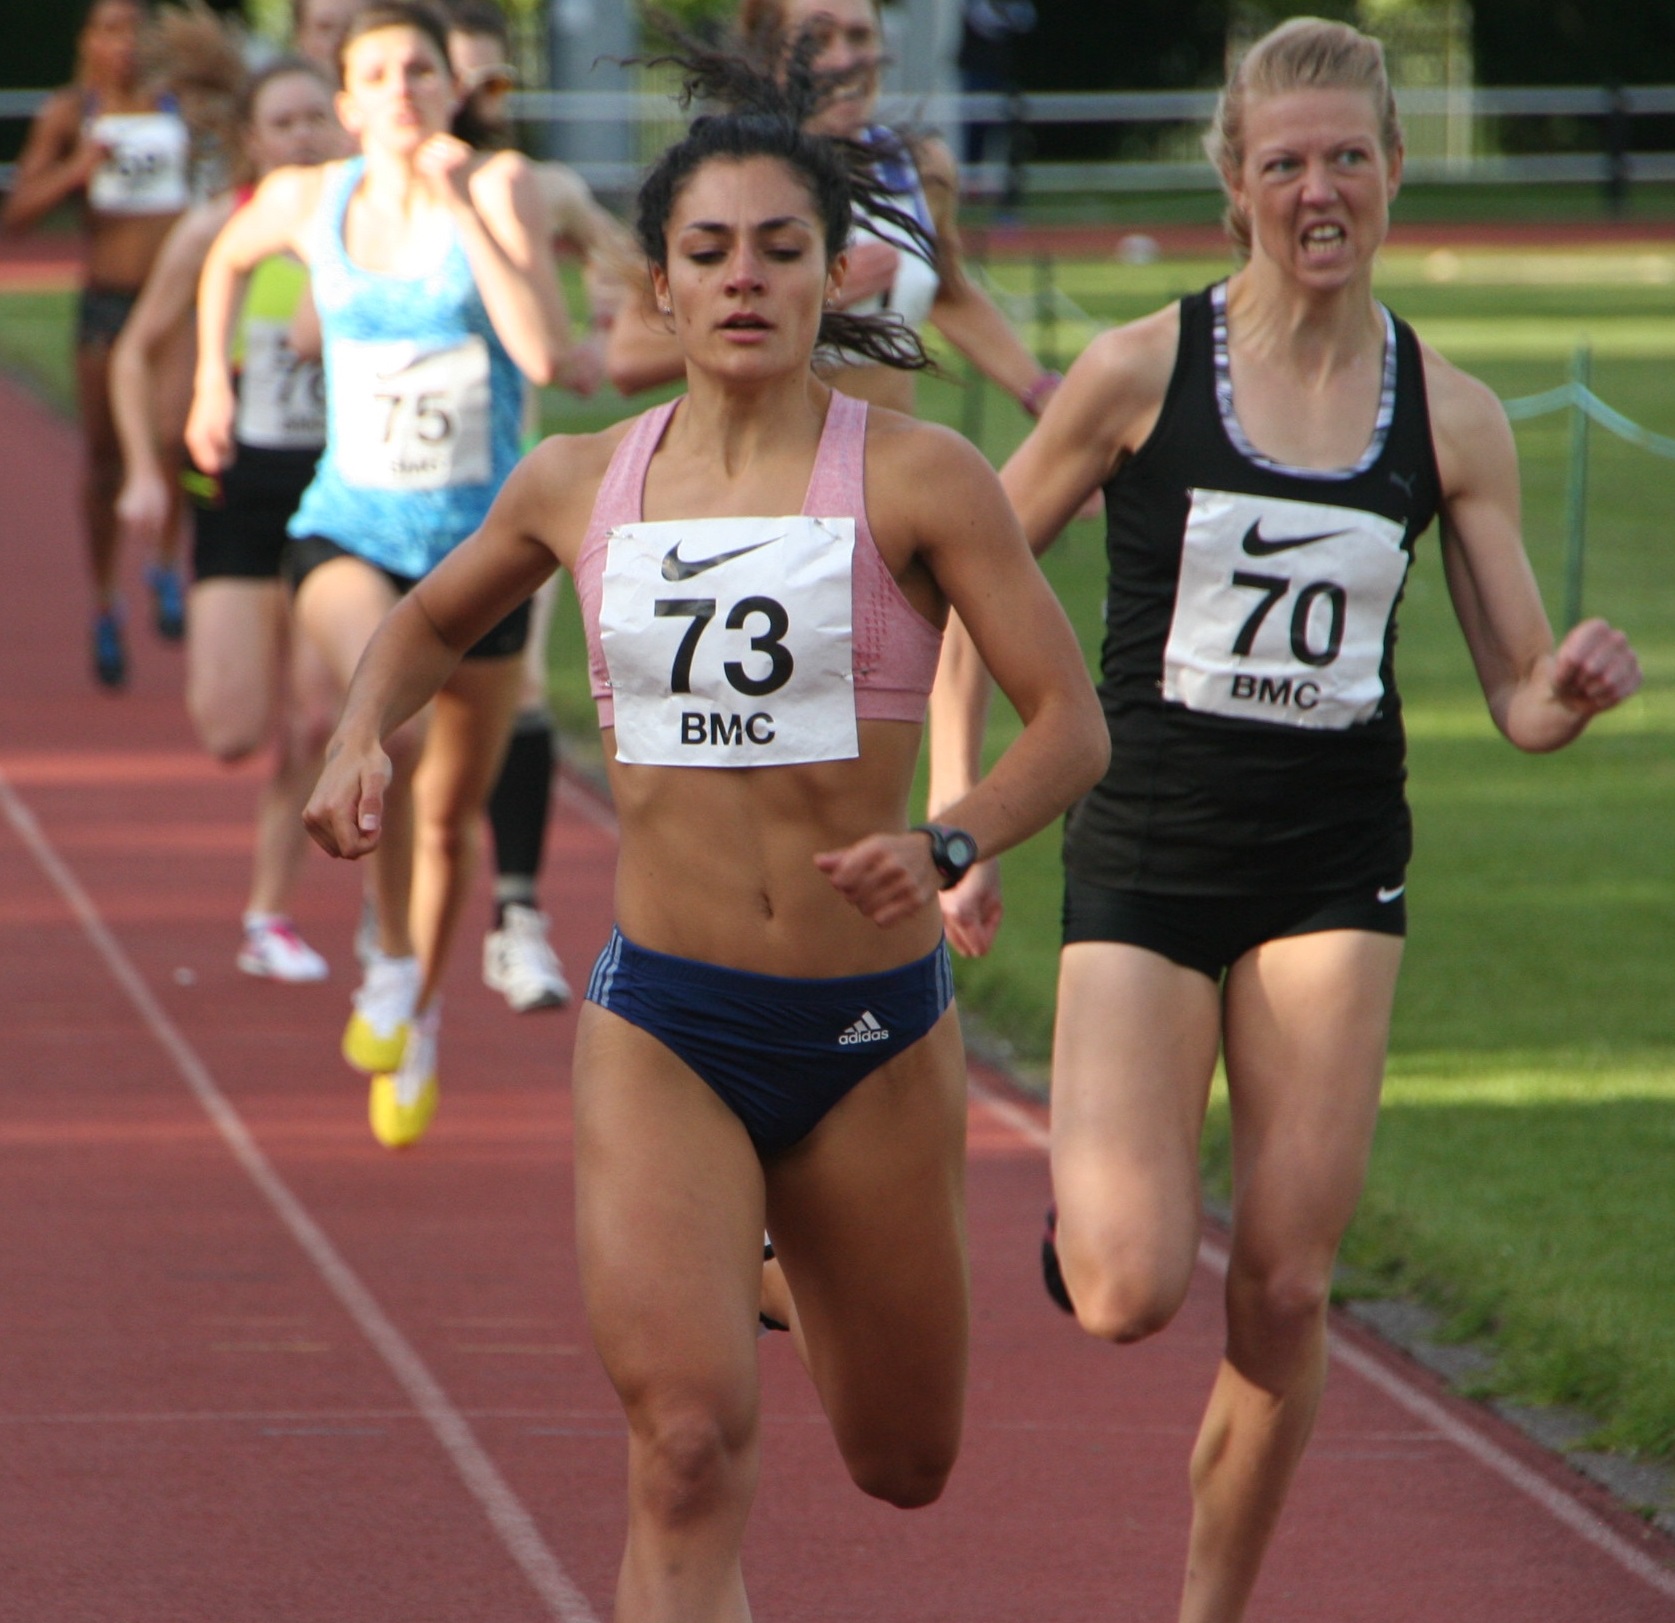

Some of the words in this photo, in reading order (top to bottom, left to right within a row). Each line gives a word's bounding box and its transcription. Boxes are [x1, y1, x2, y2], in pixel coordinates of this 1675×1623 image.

[373, 390, 453, 443] 75
[1231, 570, 1346, 667] 70
[654, 595, 794, 696] 73
[1230, 674, 1320, 710] BMC
[681, 712, 775, 745] BMC
[838, 1029, 889, 1045] adidas
